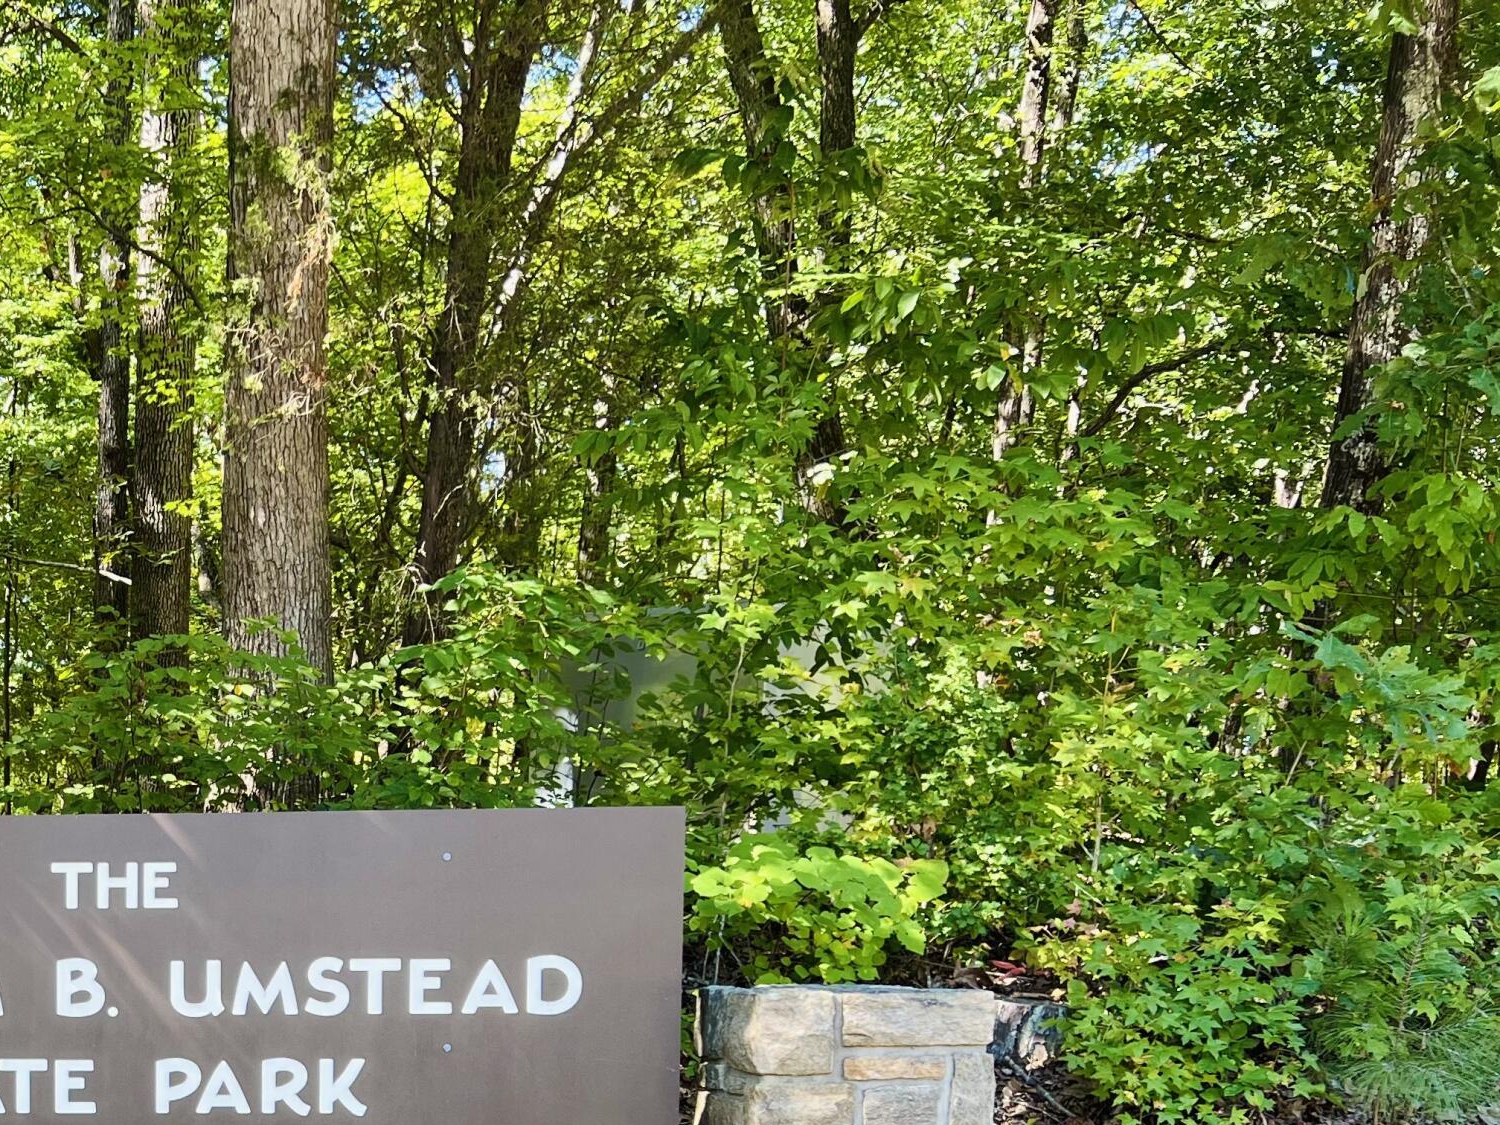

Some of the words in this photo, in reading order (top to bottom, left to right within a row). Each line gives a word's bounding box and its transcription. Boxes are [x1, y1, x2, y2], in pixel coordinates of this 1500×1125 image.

[49, 860, 180, 911] THE
[54, 956, 120, 1019] B.
[168, 953, 584, 1018] UMSTEAD
[153, 1055, 368, 1118] PARK
